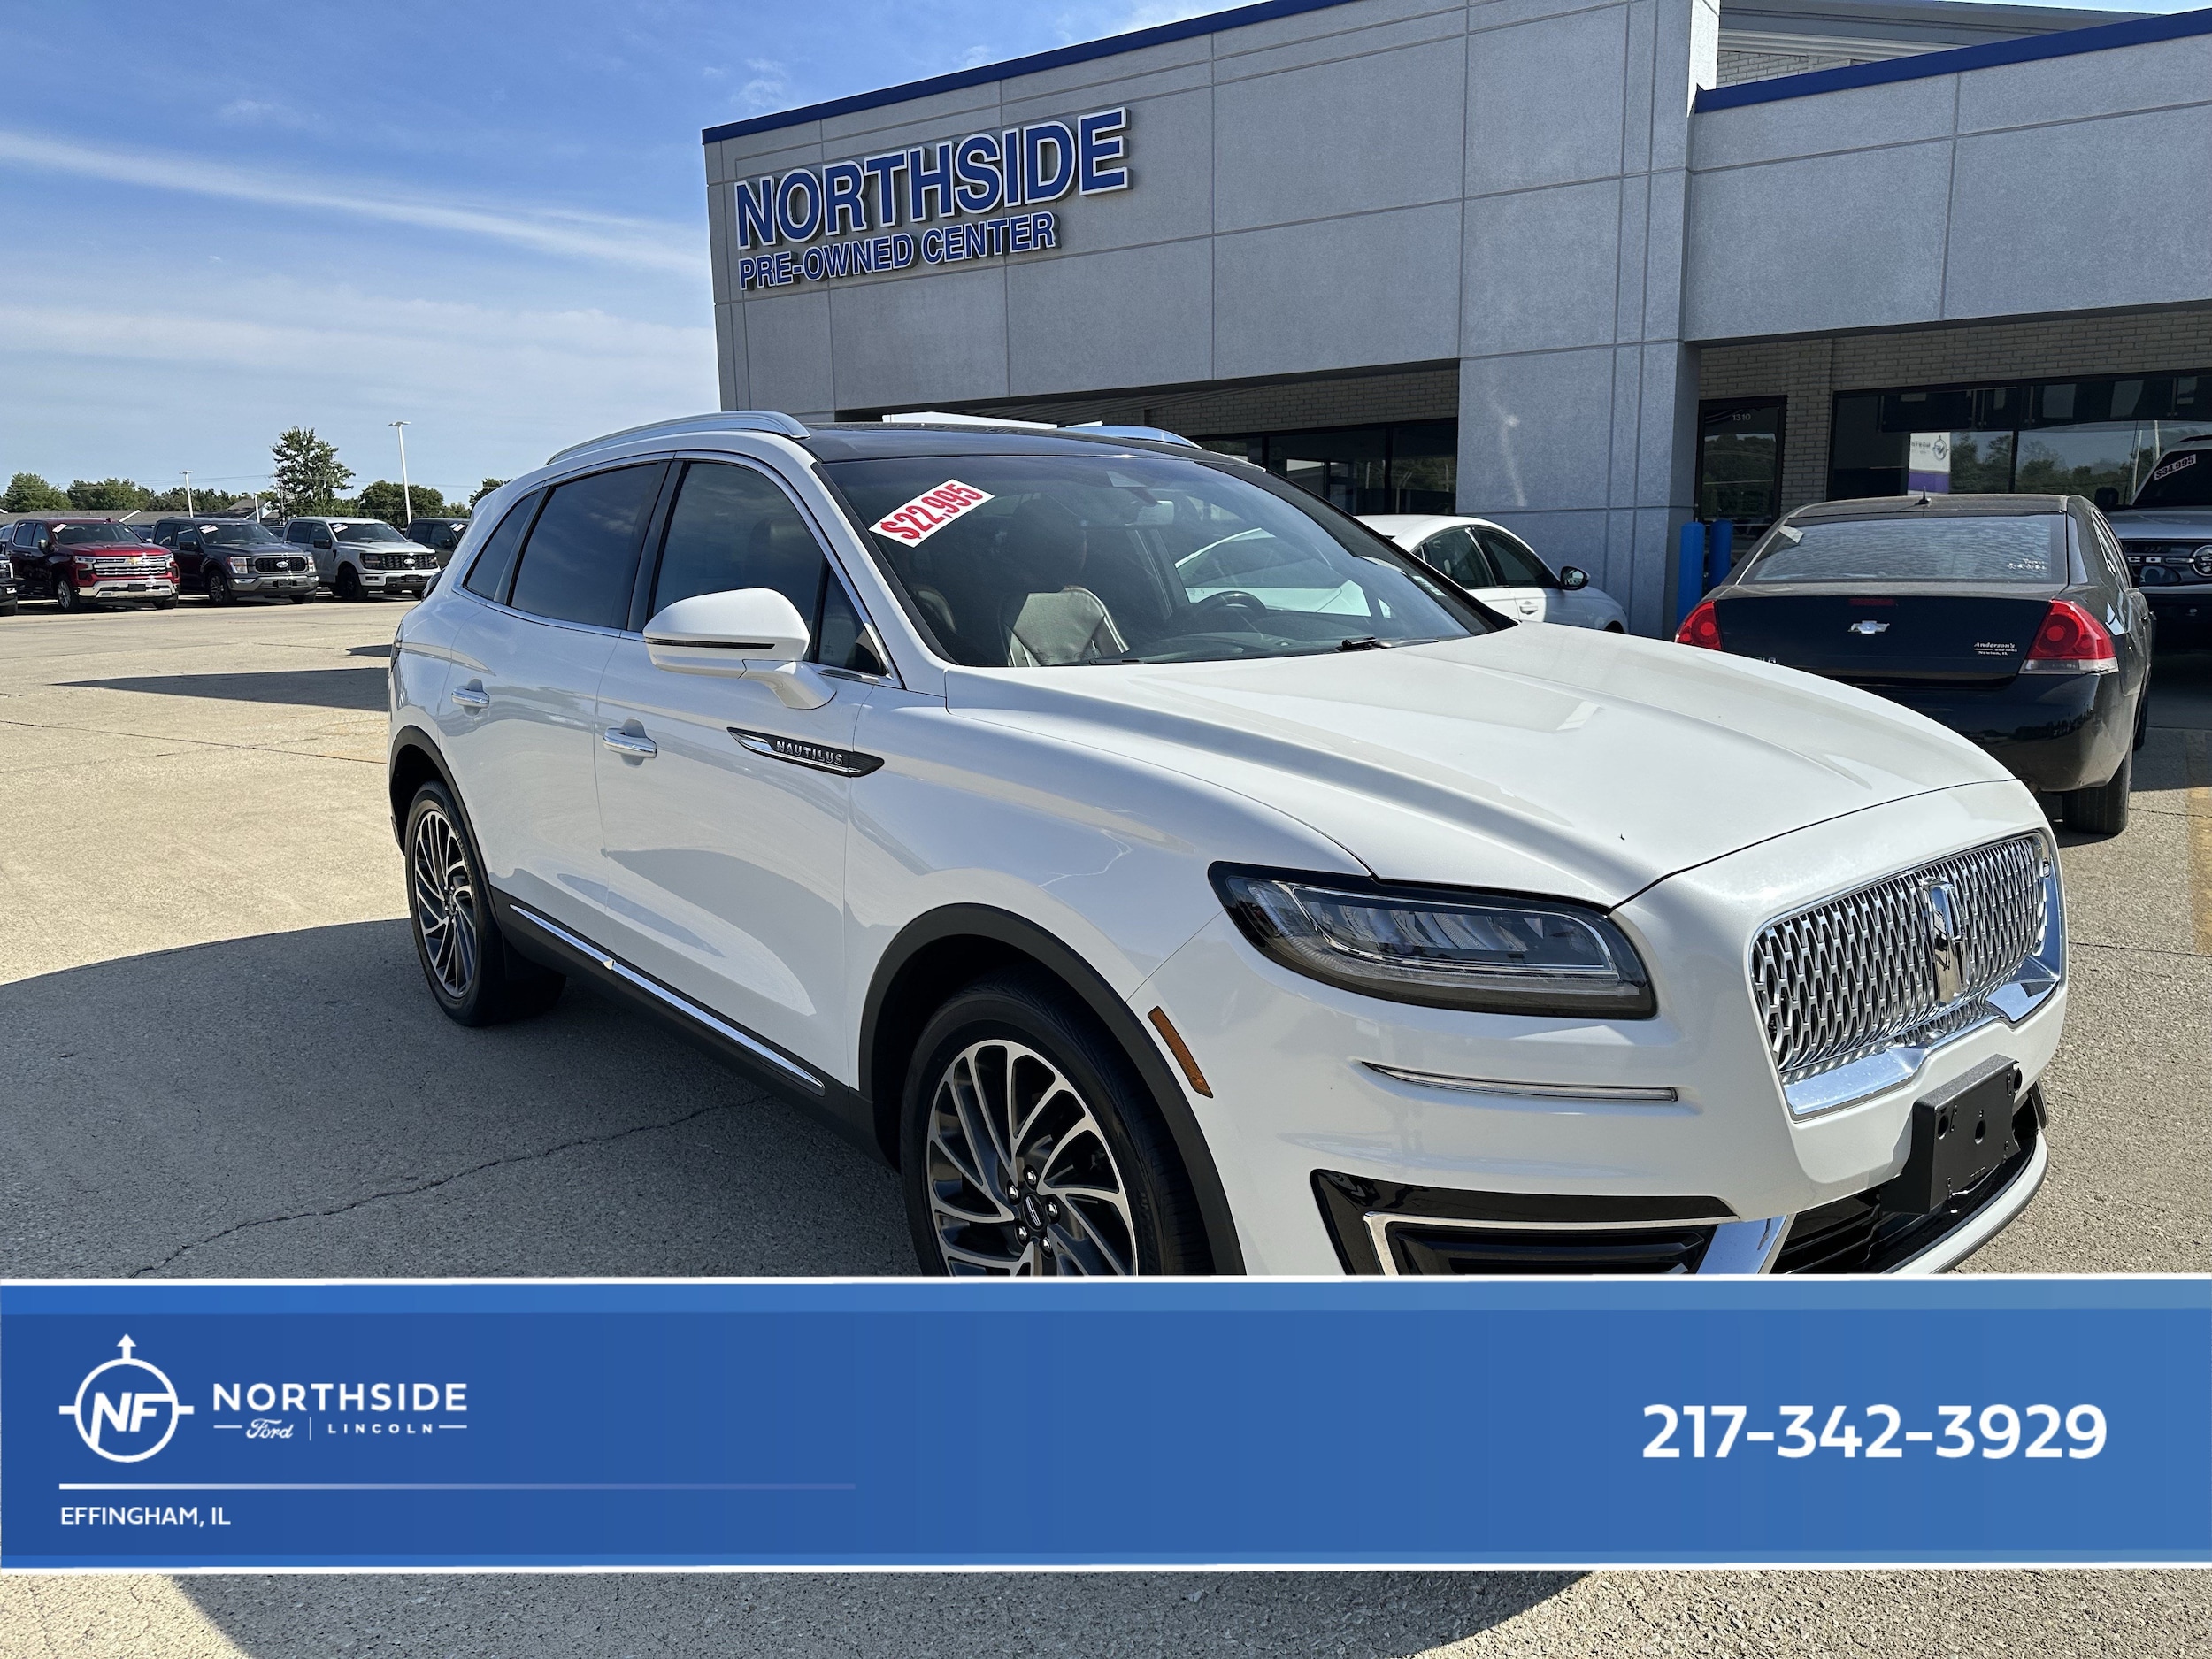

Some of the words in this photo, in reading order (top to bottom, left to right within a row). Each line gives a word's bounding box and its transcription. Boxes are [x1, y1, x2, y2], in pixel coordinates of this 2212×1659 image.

[734, 106, 1129, 250] NORTHSIDE
[739, 232, 915, 291] PRE-OWNED
[920, 211, 1056, 265] CENTER
[879, 483, 984, 540] $22,995
[776, 740, 843, 765] NAUTILUS
